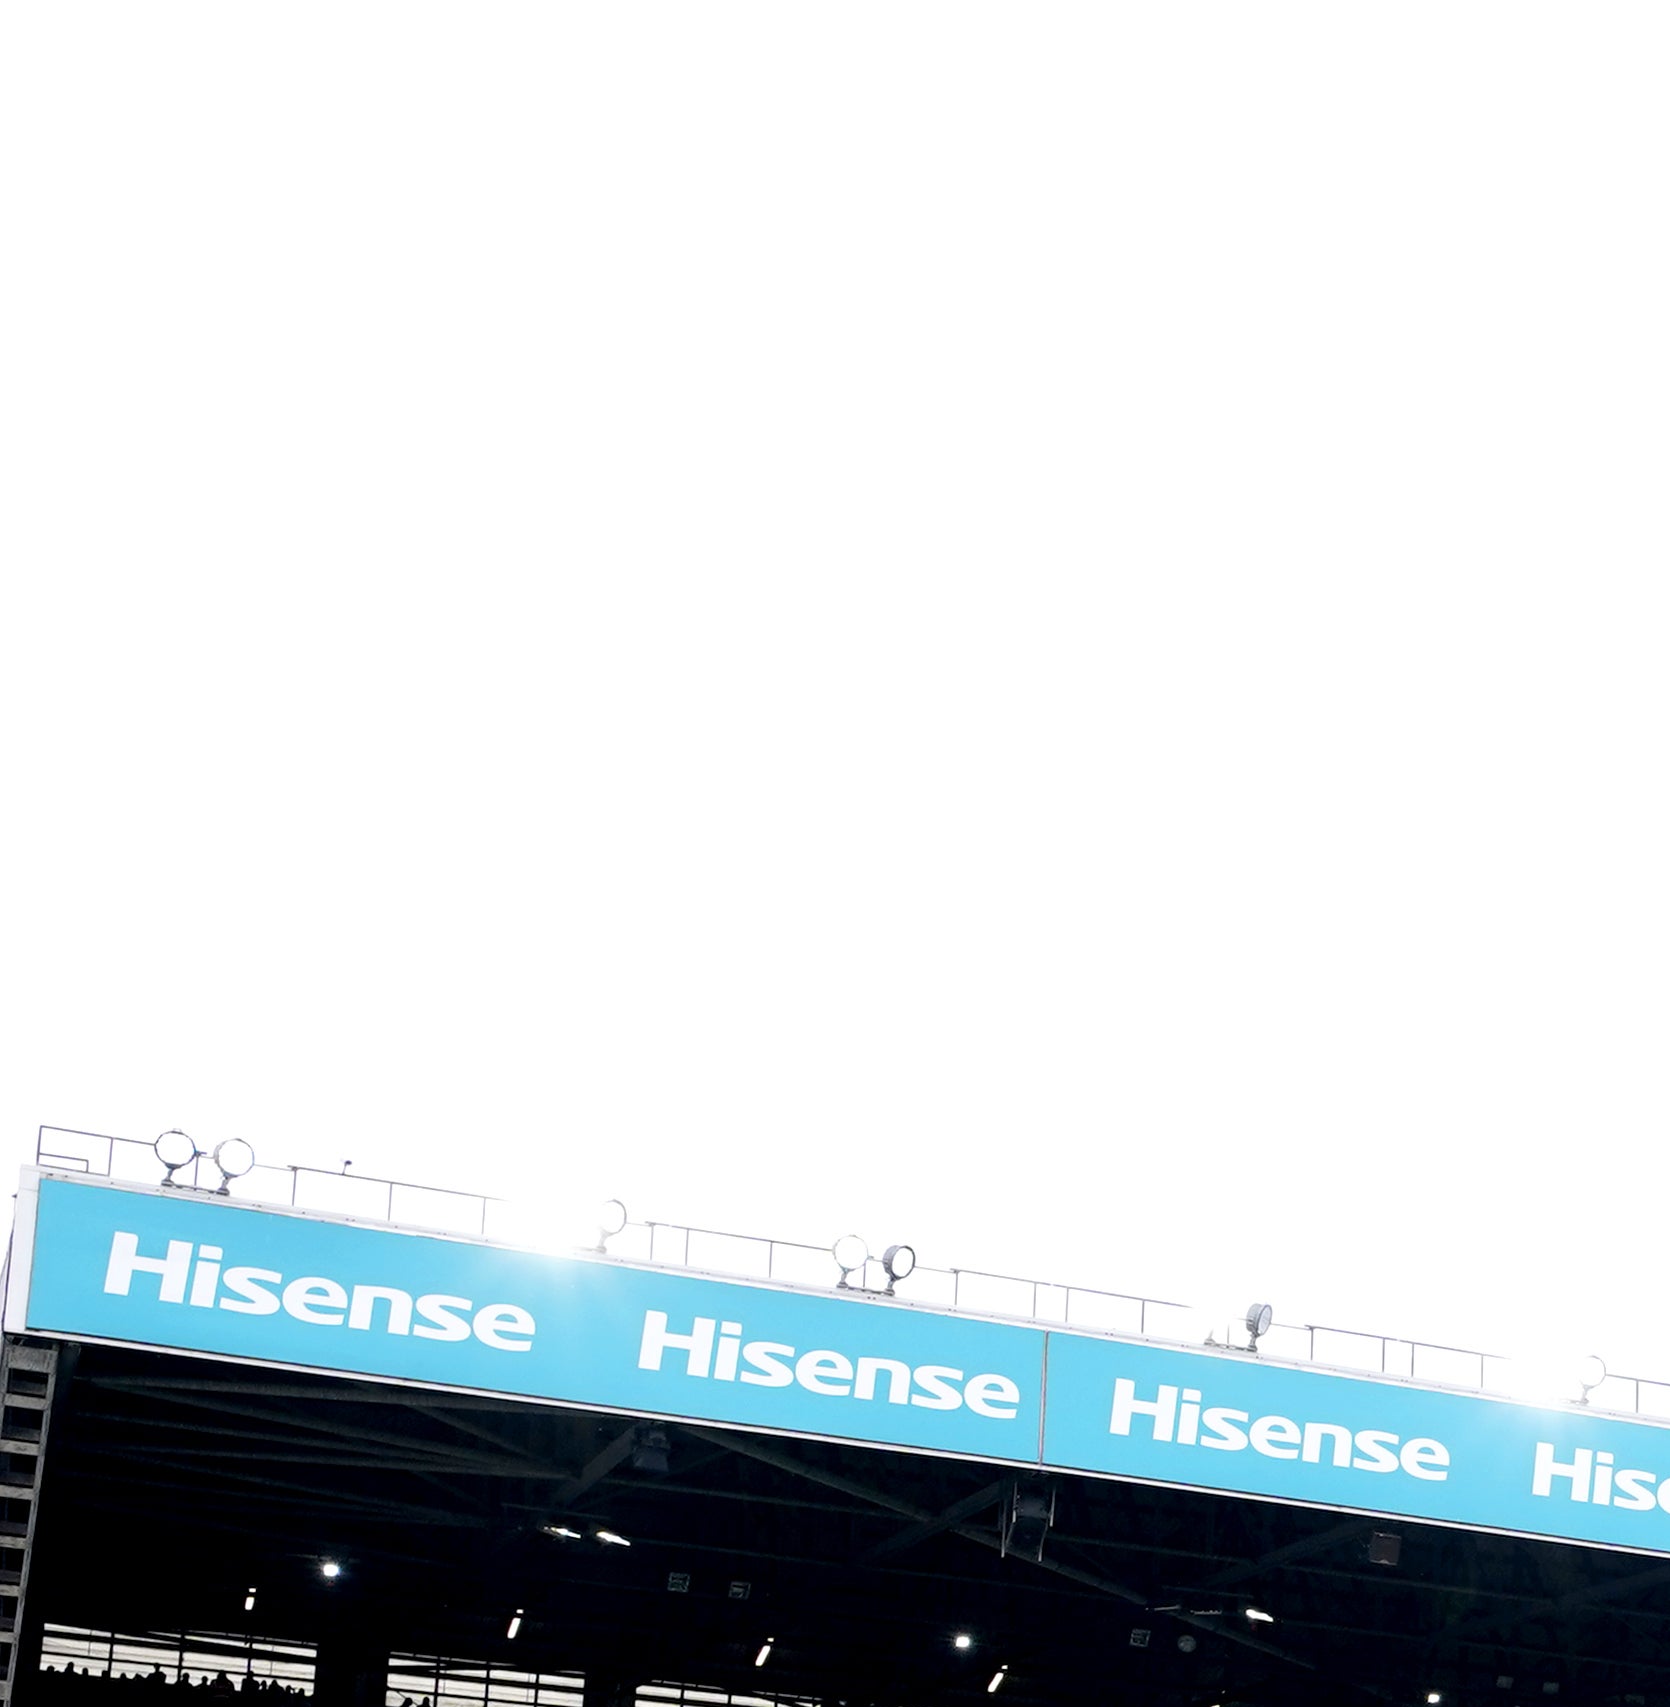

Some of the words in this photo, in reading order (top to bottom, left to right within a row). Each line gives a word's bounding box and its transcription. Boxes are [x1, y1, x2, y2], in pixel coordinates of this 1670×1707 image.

[102, 1230, 536, 1353] Hisense
[637, 1309, 1020, 1420] Hisense
[1108, 1378, 1450, 1482] Hisense
